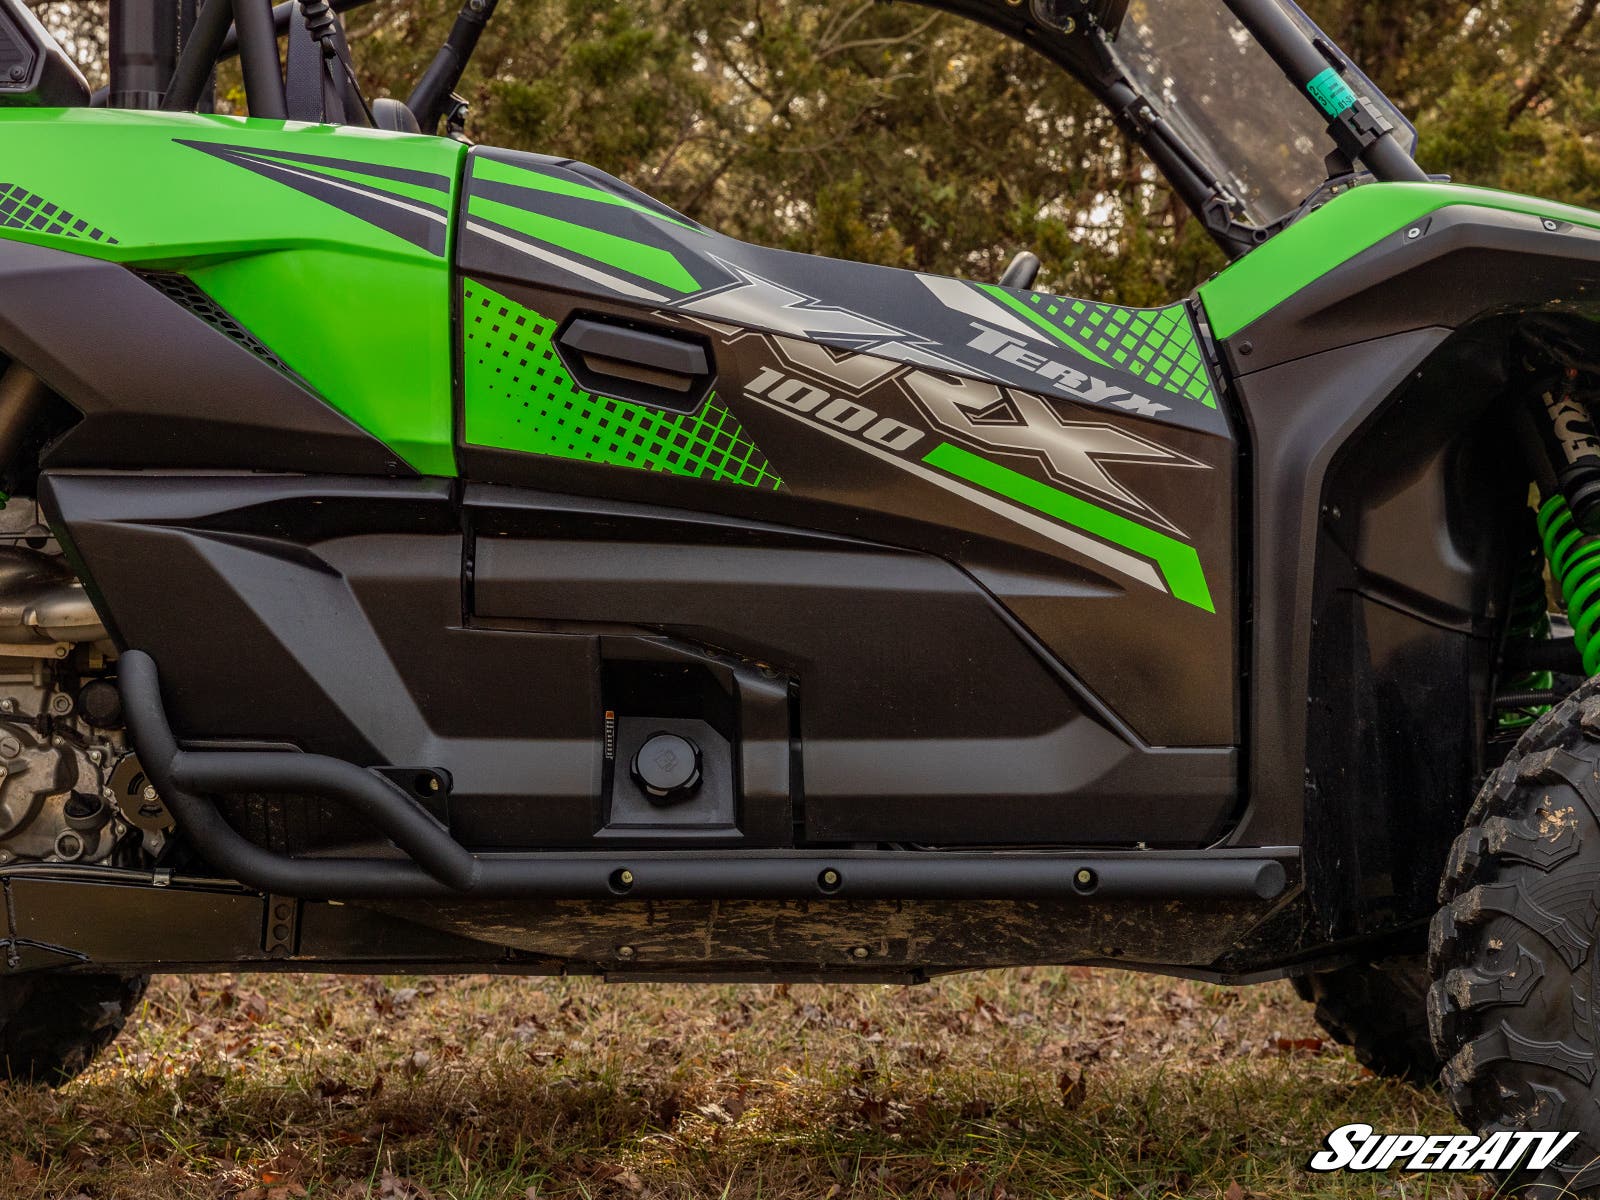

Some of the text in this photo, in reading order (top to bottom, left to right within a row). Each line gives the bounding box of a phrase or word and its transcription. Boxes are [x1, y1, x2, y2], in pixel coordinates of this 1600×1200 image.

[670, 253, 1212, 538] KRX
[744, 366, 926, 451] 1000
[963, 321, 1174, 416] TERYX
